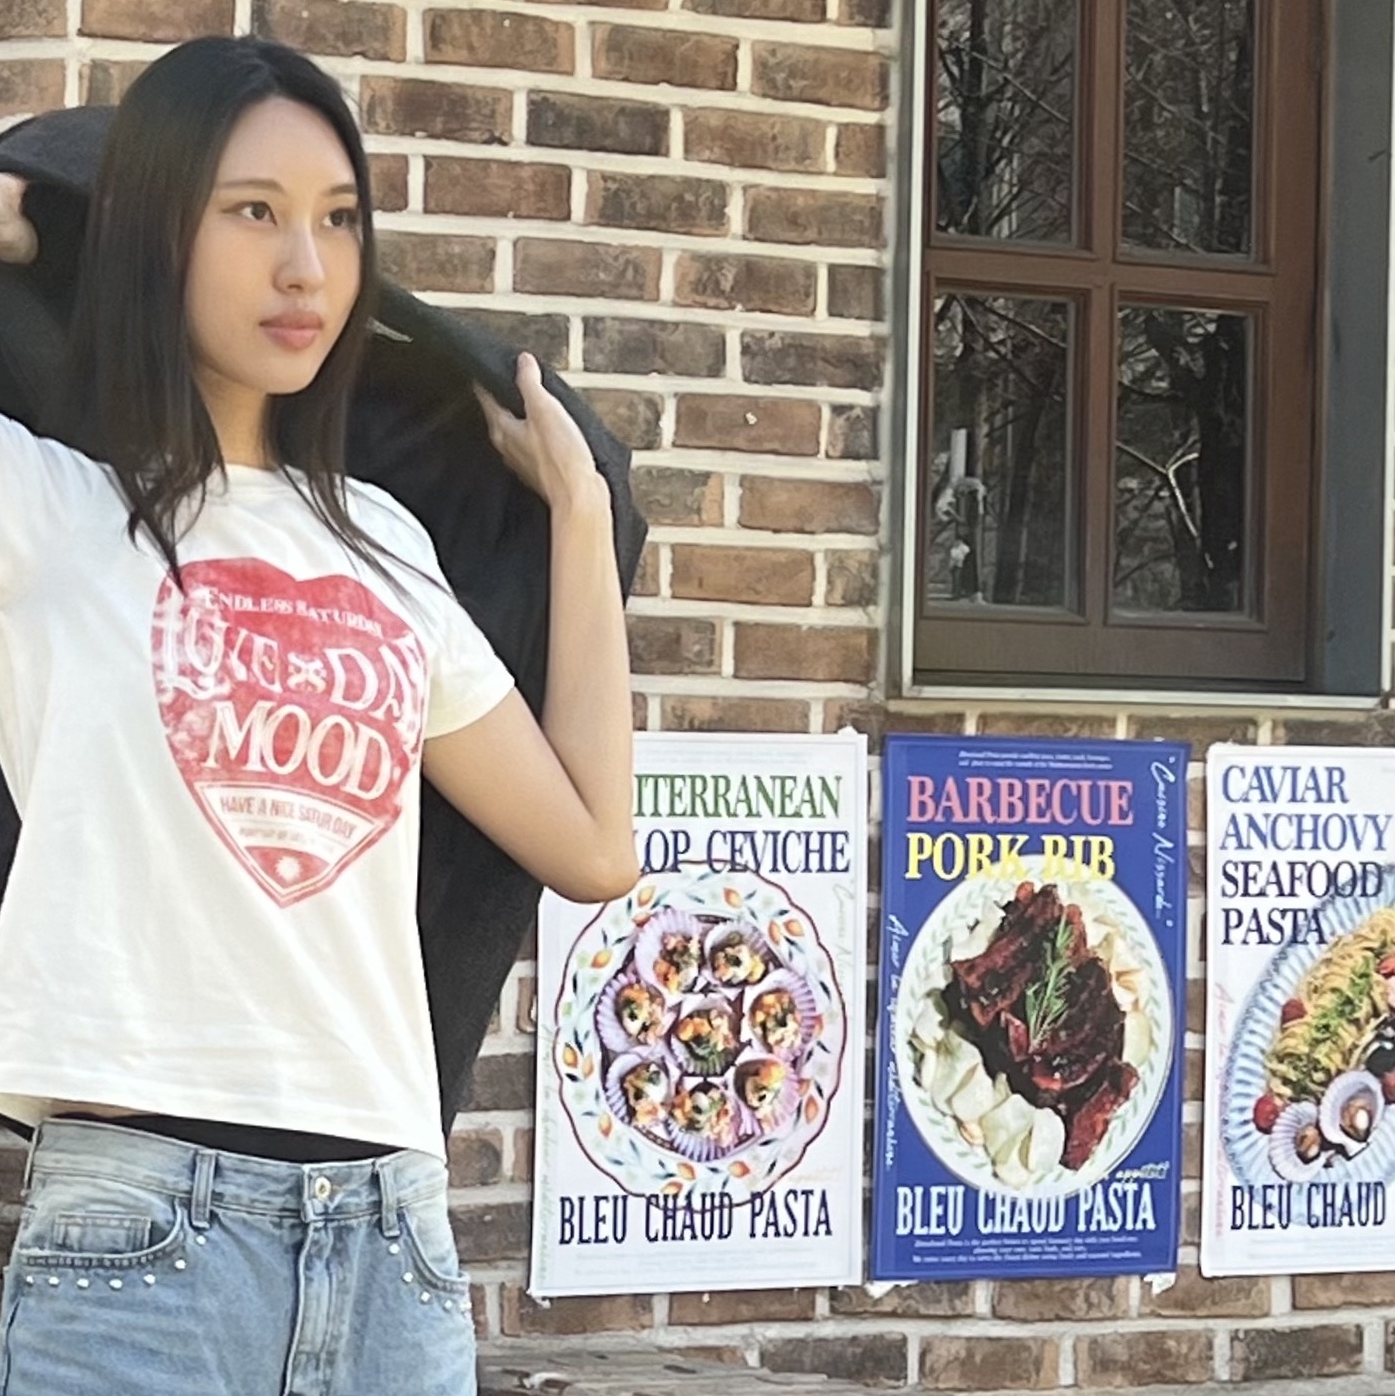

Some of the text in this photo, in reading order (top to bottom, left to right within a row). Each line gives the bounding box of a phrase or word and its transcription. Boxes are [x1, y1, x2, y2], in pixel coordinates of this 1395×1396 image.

[206, 587, 294, 614] ENDLESS
[202, 700, 392, 801] MOOD
[906, 775, 1135, 826] BARBECUE
[1221, 765, 1350, 804] CAVIAR
[220, 796, 255, 815] HAVE
[258, 799, 267, 816] A
[270, 799, 295, 819] NICE
[633, 829, 851, 874] OP CEVICHE
[1219, 813, 1394, 851] ANCHOVY
[904, 832, 1116, 881] PORK RIB
[1221, 860, 1384, 898] SEAFOOD
[1221, 907, 1329, 945] PASTA
[558, 1189, 833, 1246] BLEU CHAUD PASTA
[896, 1185, 965, 1236] BLEU
[977, 1187, 1065, 1235] CHAUD
[1077, 1182, 1157, 1232] PASTA
[1230, 1184, 1293, 1231] BLEU
[1306, 1181, 1386, 1229] CHAUD
